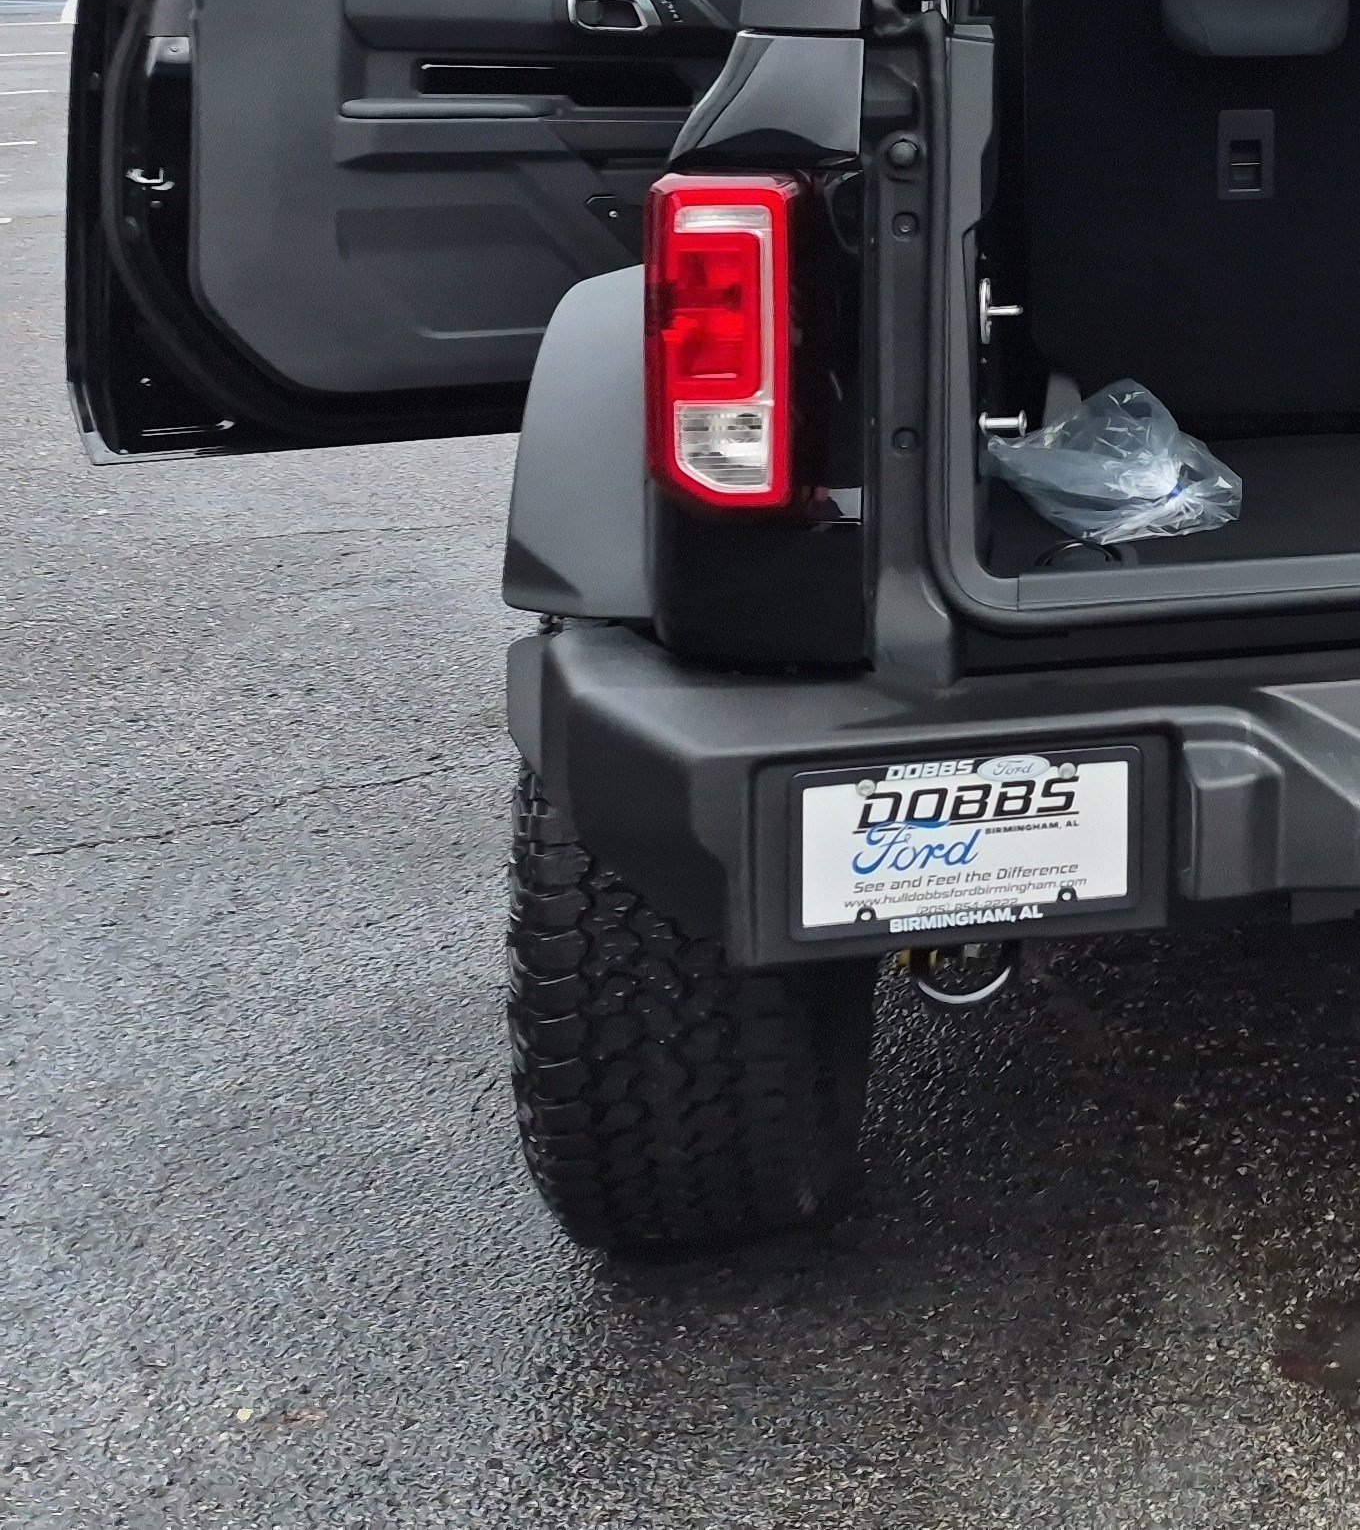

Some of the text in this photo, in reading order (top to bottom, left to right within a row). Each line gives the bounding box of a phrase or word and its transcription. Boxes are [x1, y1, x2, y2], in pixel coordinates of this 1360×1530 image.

[885, 759, 1034, 781] DOBBS Ford
[857, 776, 1079, 829] DOBBS
[985, 822, 1062, 835] BIRMINGHAM,
[852, 819, 981, 875] Ford
[853, 863, 1079, 894] See and Feel the Difference
[889, 905, 1044, 933] BIRMINGHAM, AL
